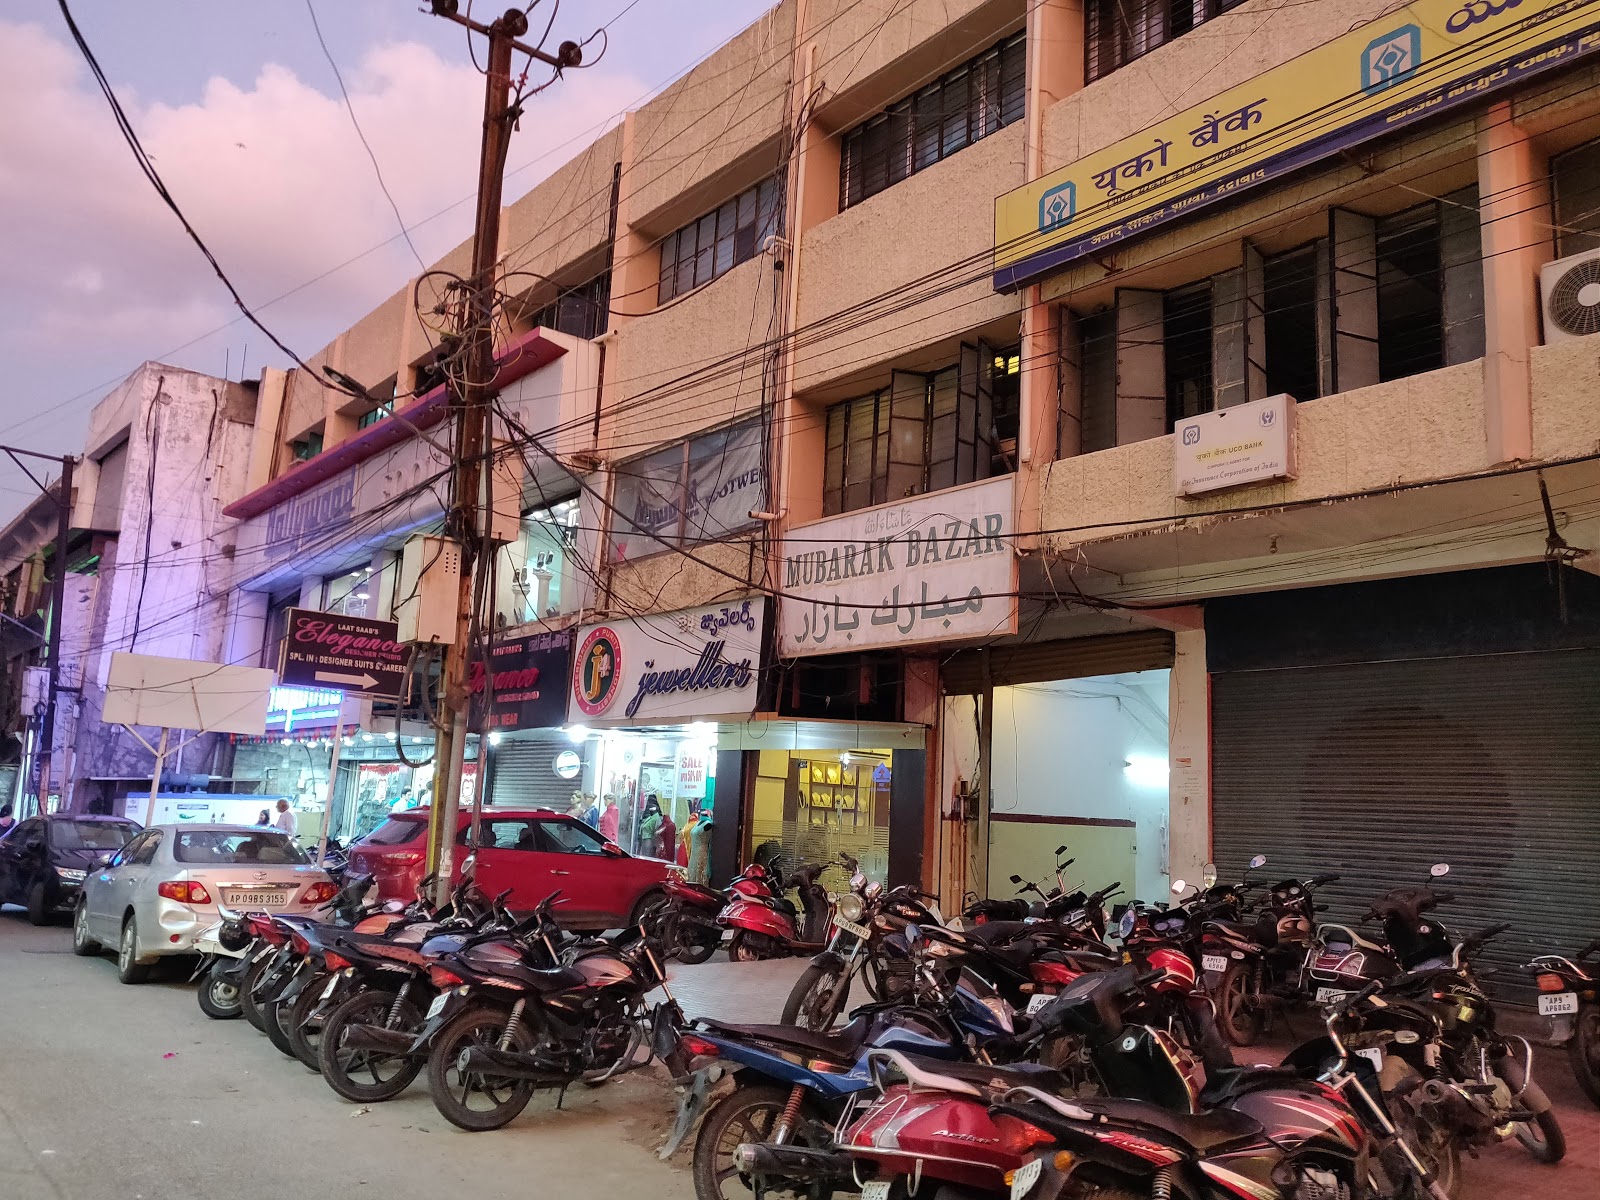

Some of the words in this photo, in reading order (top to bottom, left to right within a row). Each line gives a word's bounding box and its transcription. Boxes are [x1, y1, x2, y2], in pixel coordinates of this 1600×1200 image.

[1091, 139, 1173, 197] यूको
[1188, 97, 1268, 148] बैंक
[1228, 445, 1243, 454] UCO
[1244, 440, 1263, 450] BANK
[1191, 475, 1219, 485] Insurance
[1219, 467, 1253, 479] Corporation
[1253, 464, 1260, 472] of
[1261, 461, 1279, 470] India
[785, 535, 895, 588] MUBARAK
[905, 513, 1005, 568] BAZAR
[295, 617, 406, 655] Elegance
[338, 623, 354, 632] LAAT
[356, 625, 379, 635] SAAB'S
[601, 628, 620, 650] PURITY
[289, 651, 304, 661] SPL.
[306, 653, 314, 662] IN
[319, 656, 353, 667] DESIGNER
[354, 660, 374, 670] SUITS
[381, 663, 407, 673] SAREES
[345, 648, 377, 658] DESIGNER
[625, 639, 752, 718] jewellers
[681, 756, 703, 769] SALE
[230, 894, 240, 903] AP
[242, 894, 264, 904] 09BS
[265, 894, 285, 904] 3155
